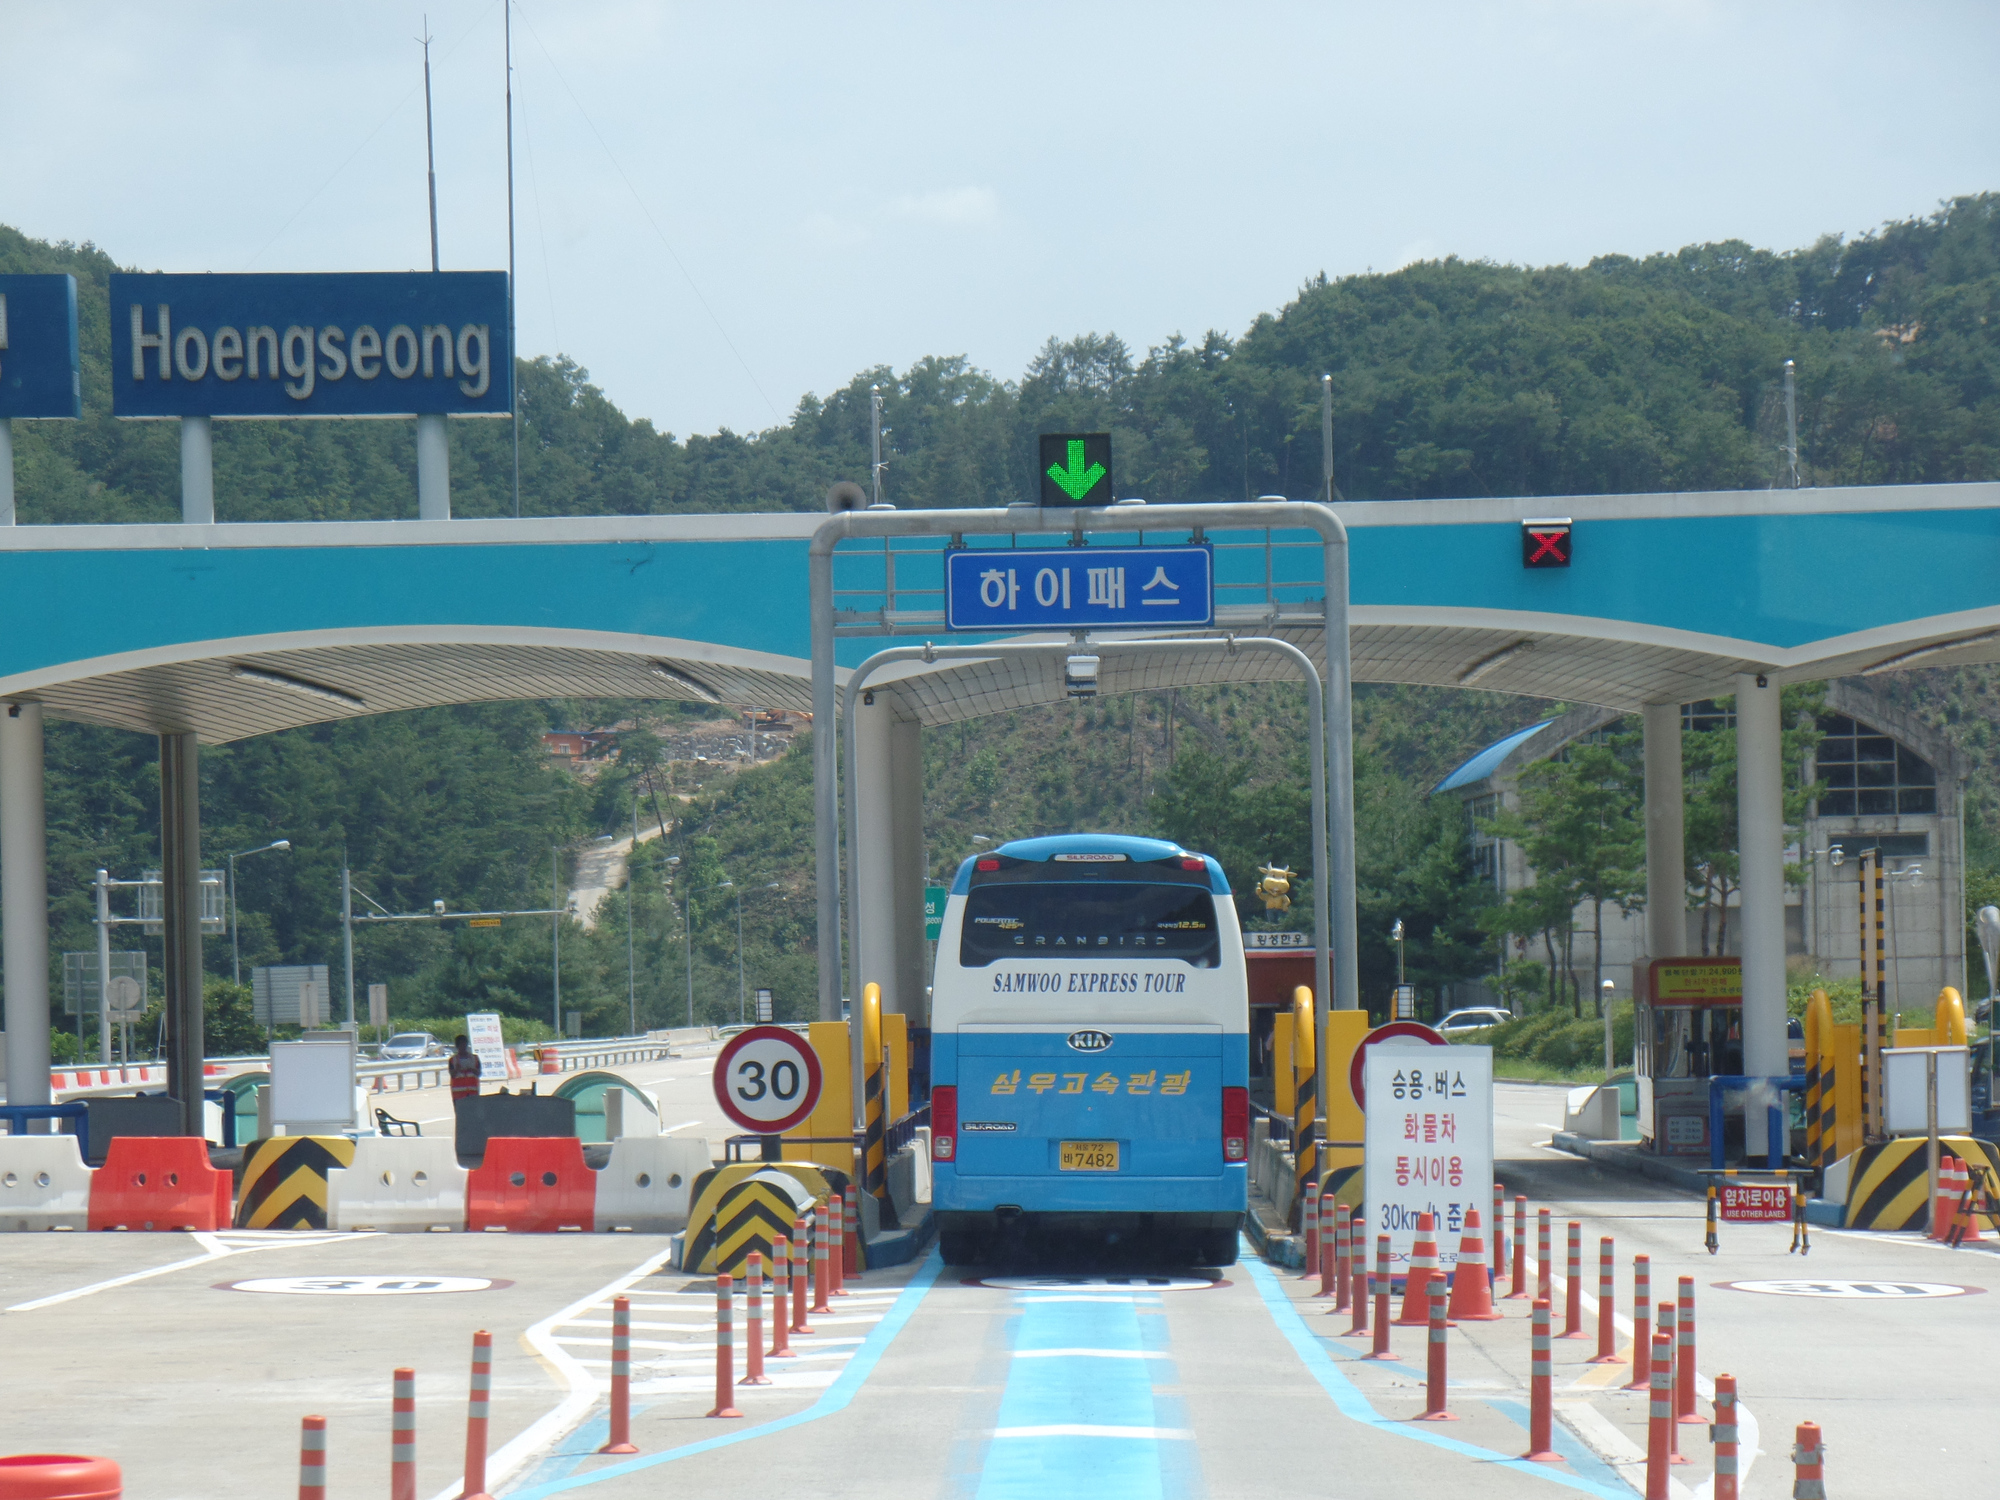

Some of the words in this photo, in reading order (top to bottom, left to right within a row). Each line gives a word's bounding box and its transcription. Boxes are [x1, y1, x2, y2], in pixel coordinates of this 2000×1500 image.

[130, 303, 491, 399] Hoengseong
[980, 566, 1180, 610] 하이패스
[1014, 936, 1167, 945] GRANBIRD
[1257, 934, 1303, 945] 횡성한우
[993, 973, 1061, 993] SAMWOO
[1067, 973, 1138, 993] EXPRESS
[1144, 973, 1186, 993] TOUR
[1074, 1034, 1106, 1047] KIA
[737, 1060, 800, 1101] 30
[991, 1069, 1192, 1095] 삼우고속관광
[965, 1123, 1015, 1131] SILKROAD
[1404, 1113, 1457, 1143] 화물차
[1075, 1144, 1090, 1152] 서울
[1092, 1144, 1105, 1152] 72
[1075, 1153, 1115, 1168] 7482
[1395, 1156, 1463, 1187] 동시이용
[1725, 1189, 1786, 1208] 옆차로이용
[1381, 1202, 1441, 1231] 30km/h
[290, 1281, 442, 1289] 30
[1766, 1284, 1929, 1294] 30
